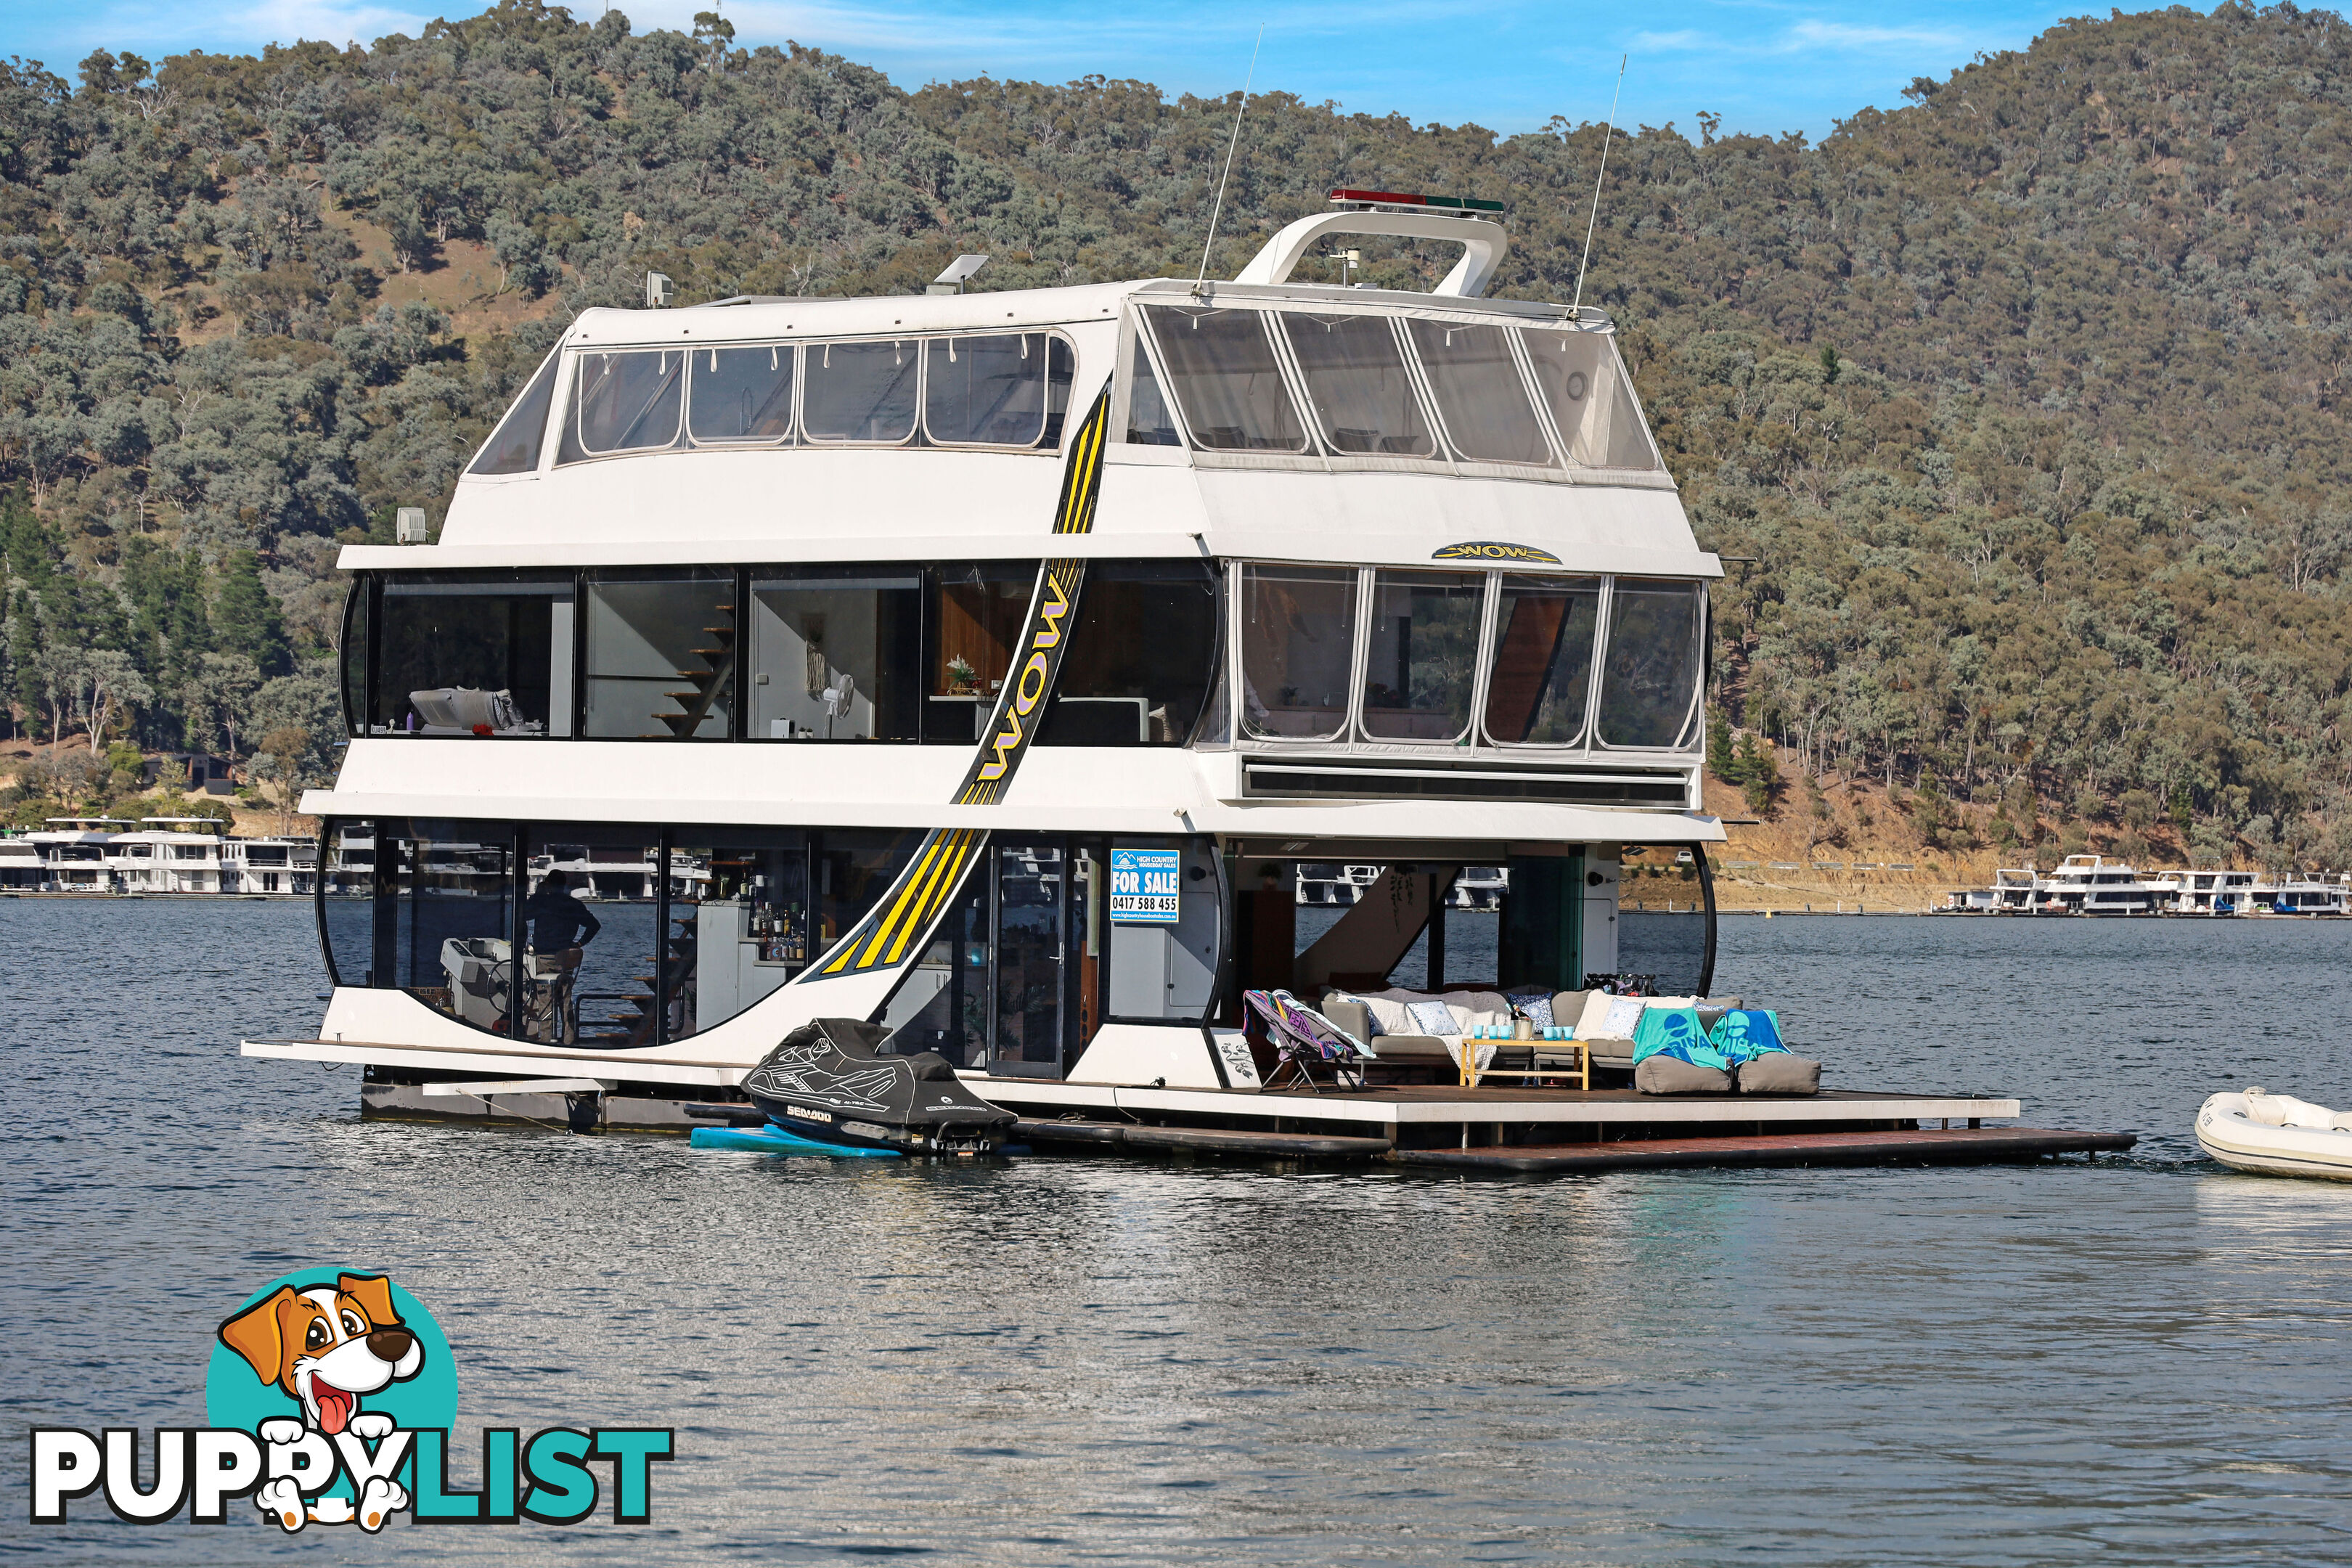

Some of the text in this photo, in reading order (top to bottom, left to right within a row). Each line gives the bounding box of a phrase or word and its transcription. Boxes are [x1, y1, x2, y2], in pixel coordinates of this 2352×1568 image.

[1457, 545, 1528, 558] WOW
[976, 573, 1069, 781] WOW
[1112, 871, 1177, 894] FOR SALE
[1112, 897, 1176, 910] 0417 588 455
